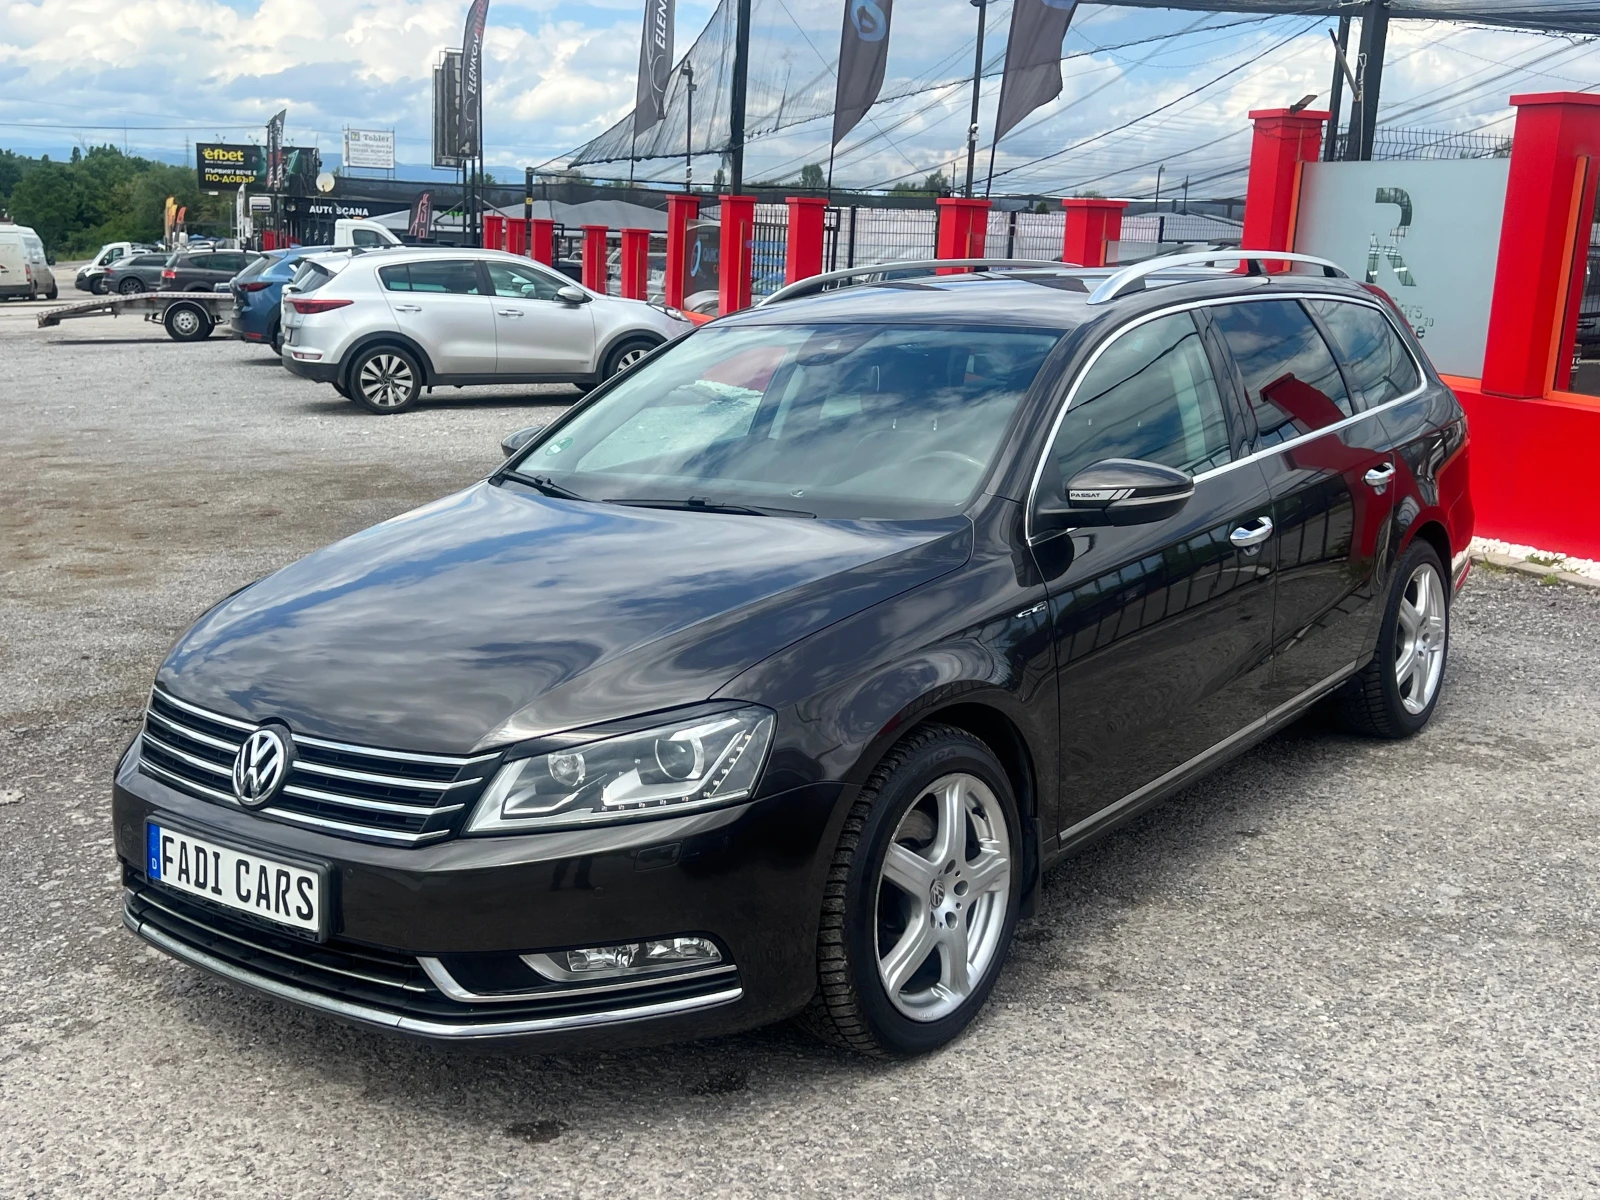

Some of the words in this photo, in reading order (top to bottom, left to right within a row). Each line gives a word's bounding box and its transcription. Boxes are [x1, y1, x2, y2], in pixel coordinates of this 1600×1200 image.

[655, 0, 668, 49] ELEN
[467, 33, 480, 95] ELENKOV
[203, 149, 244, 161] efbet
[205, 174, 255, 183] ПО-ДОБЪР
[336, 207, 369, 216] SCANA
[161, 835, 222, 896] FADI
[235, 858, 315, 921] CARS
